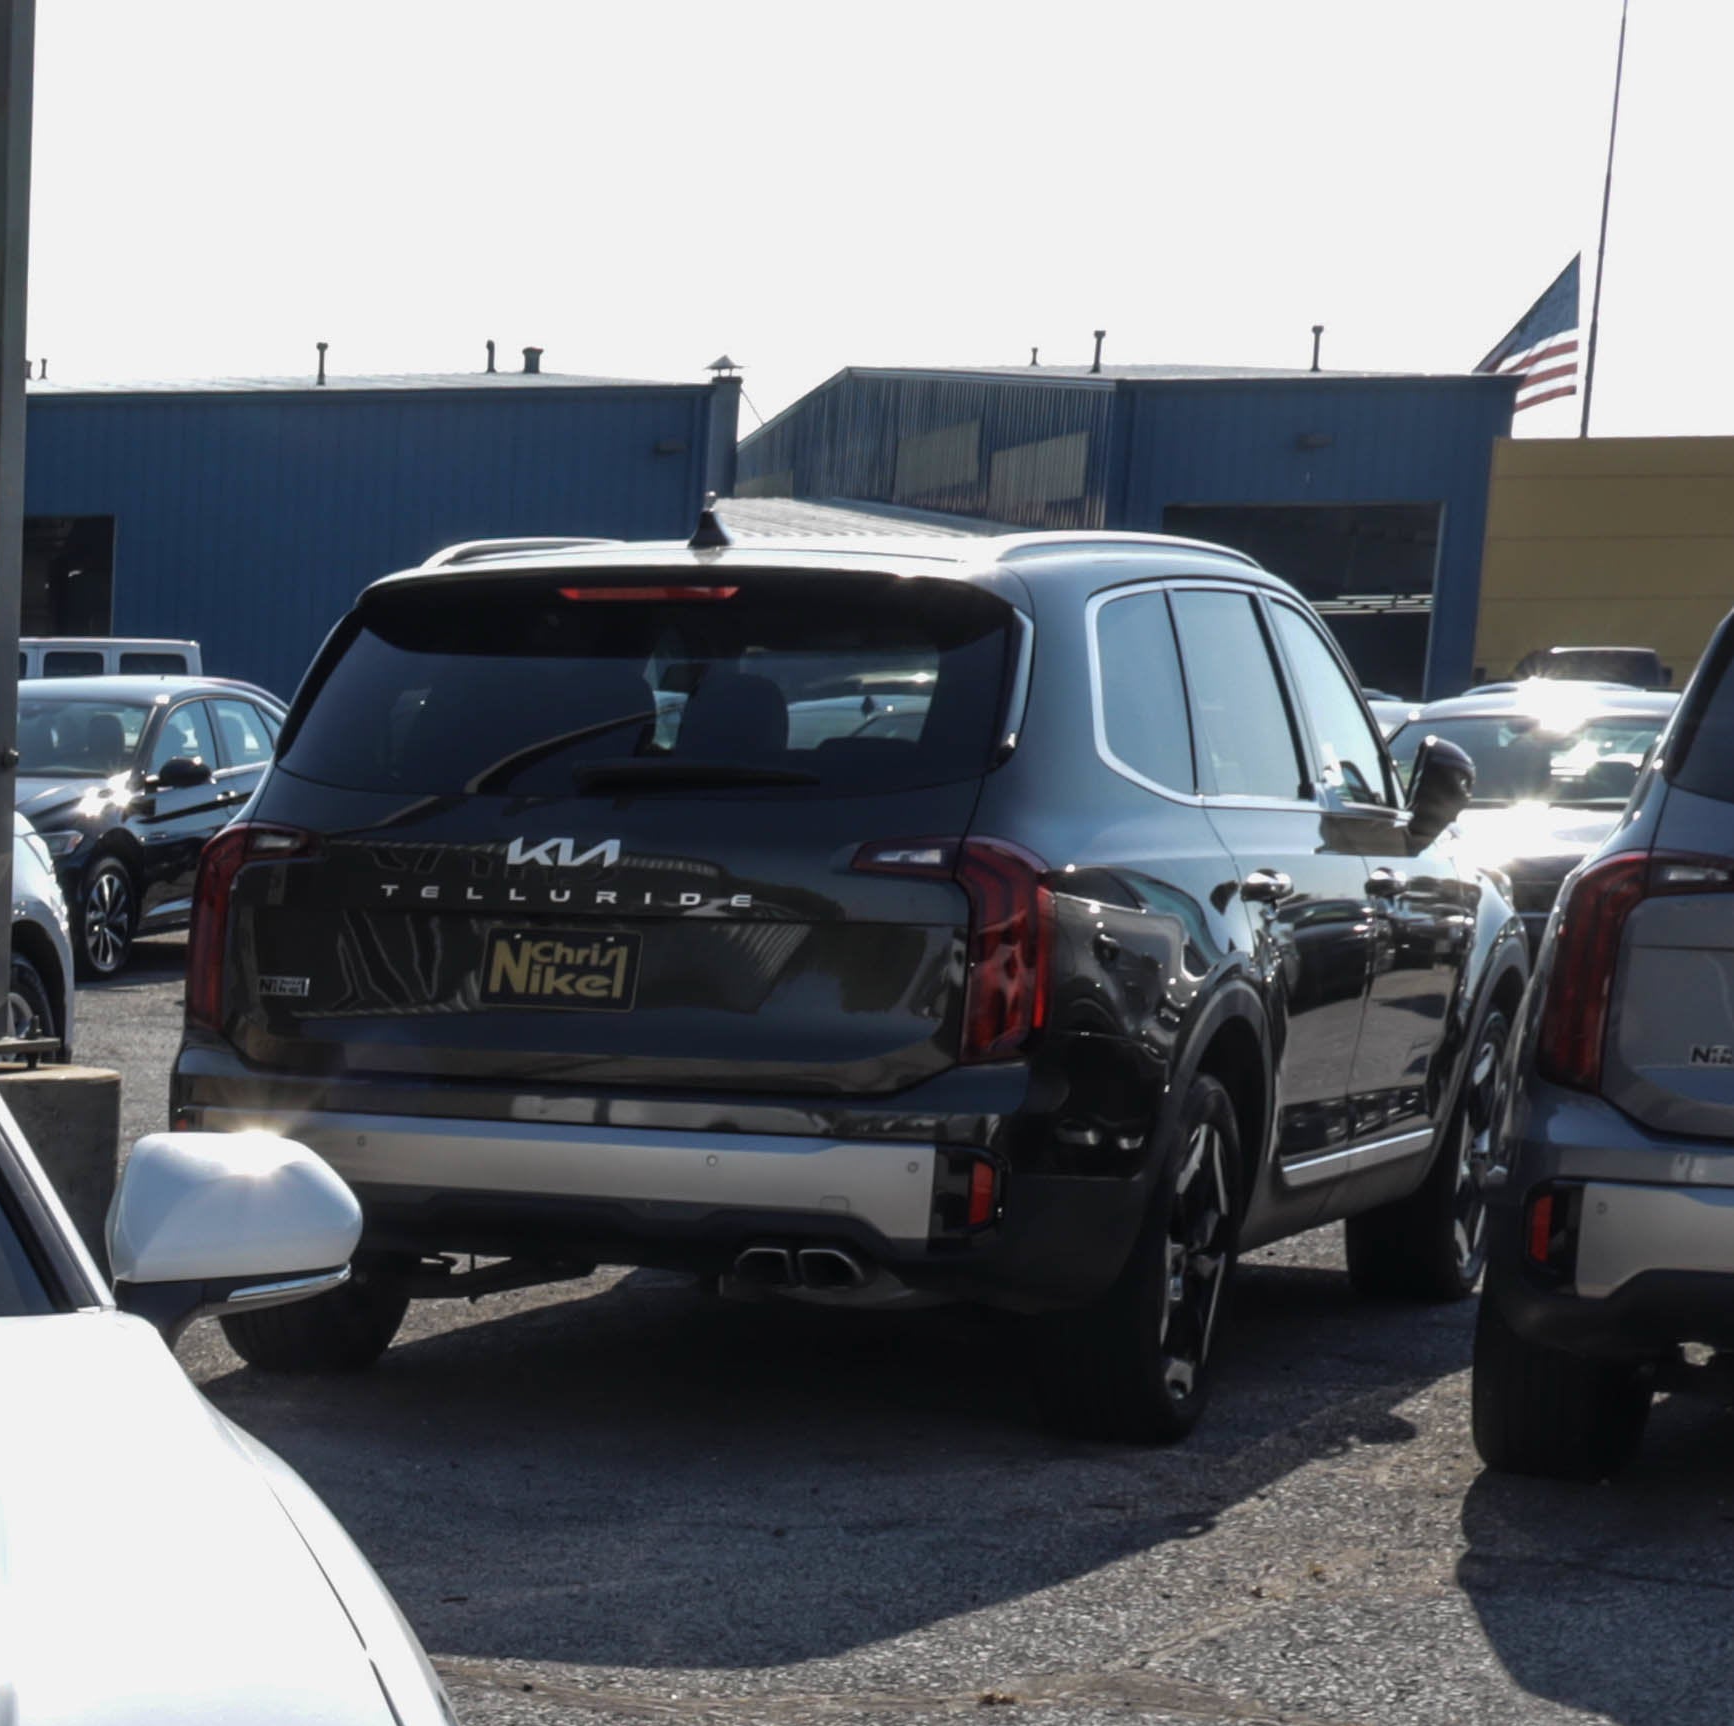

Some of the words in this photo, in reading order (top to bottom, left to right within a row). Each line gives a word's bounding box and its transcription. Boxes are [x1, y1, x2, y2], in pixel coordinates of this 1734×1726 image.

[506, 836, 621, 868] KIA
[380, 884, 753, 908] TELLURIDE
[532, 940, 619, 967] Chris
[488, 939, 628, 1000] Nikel
